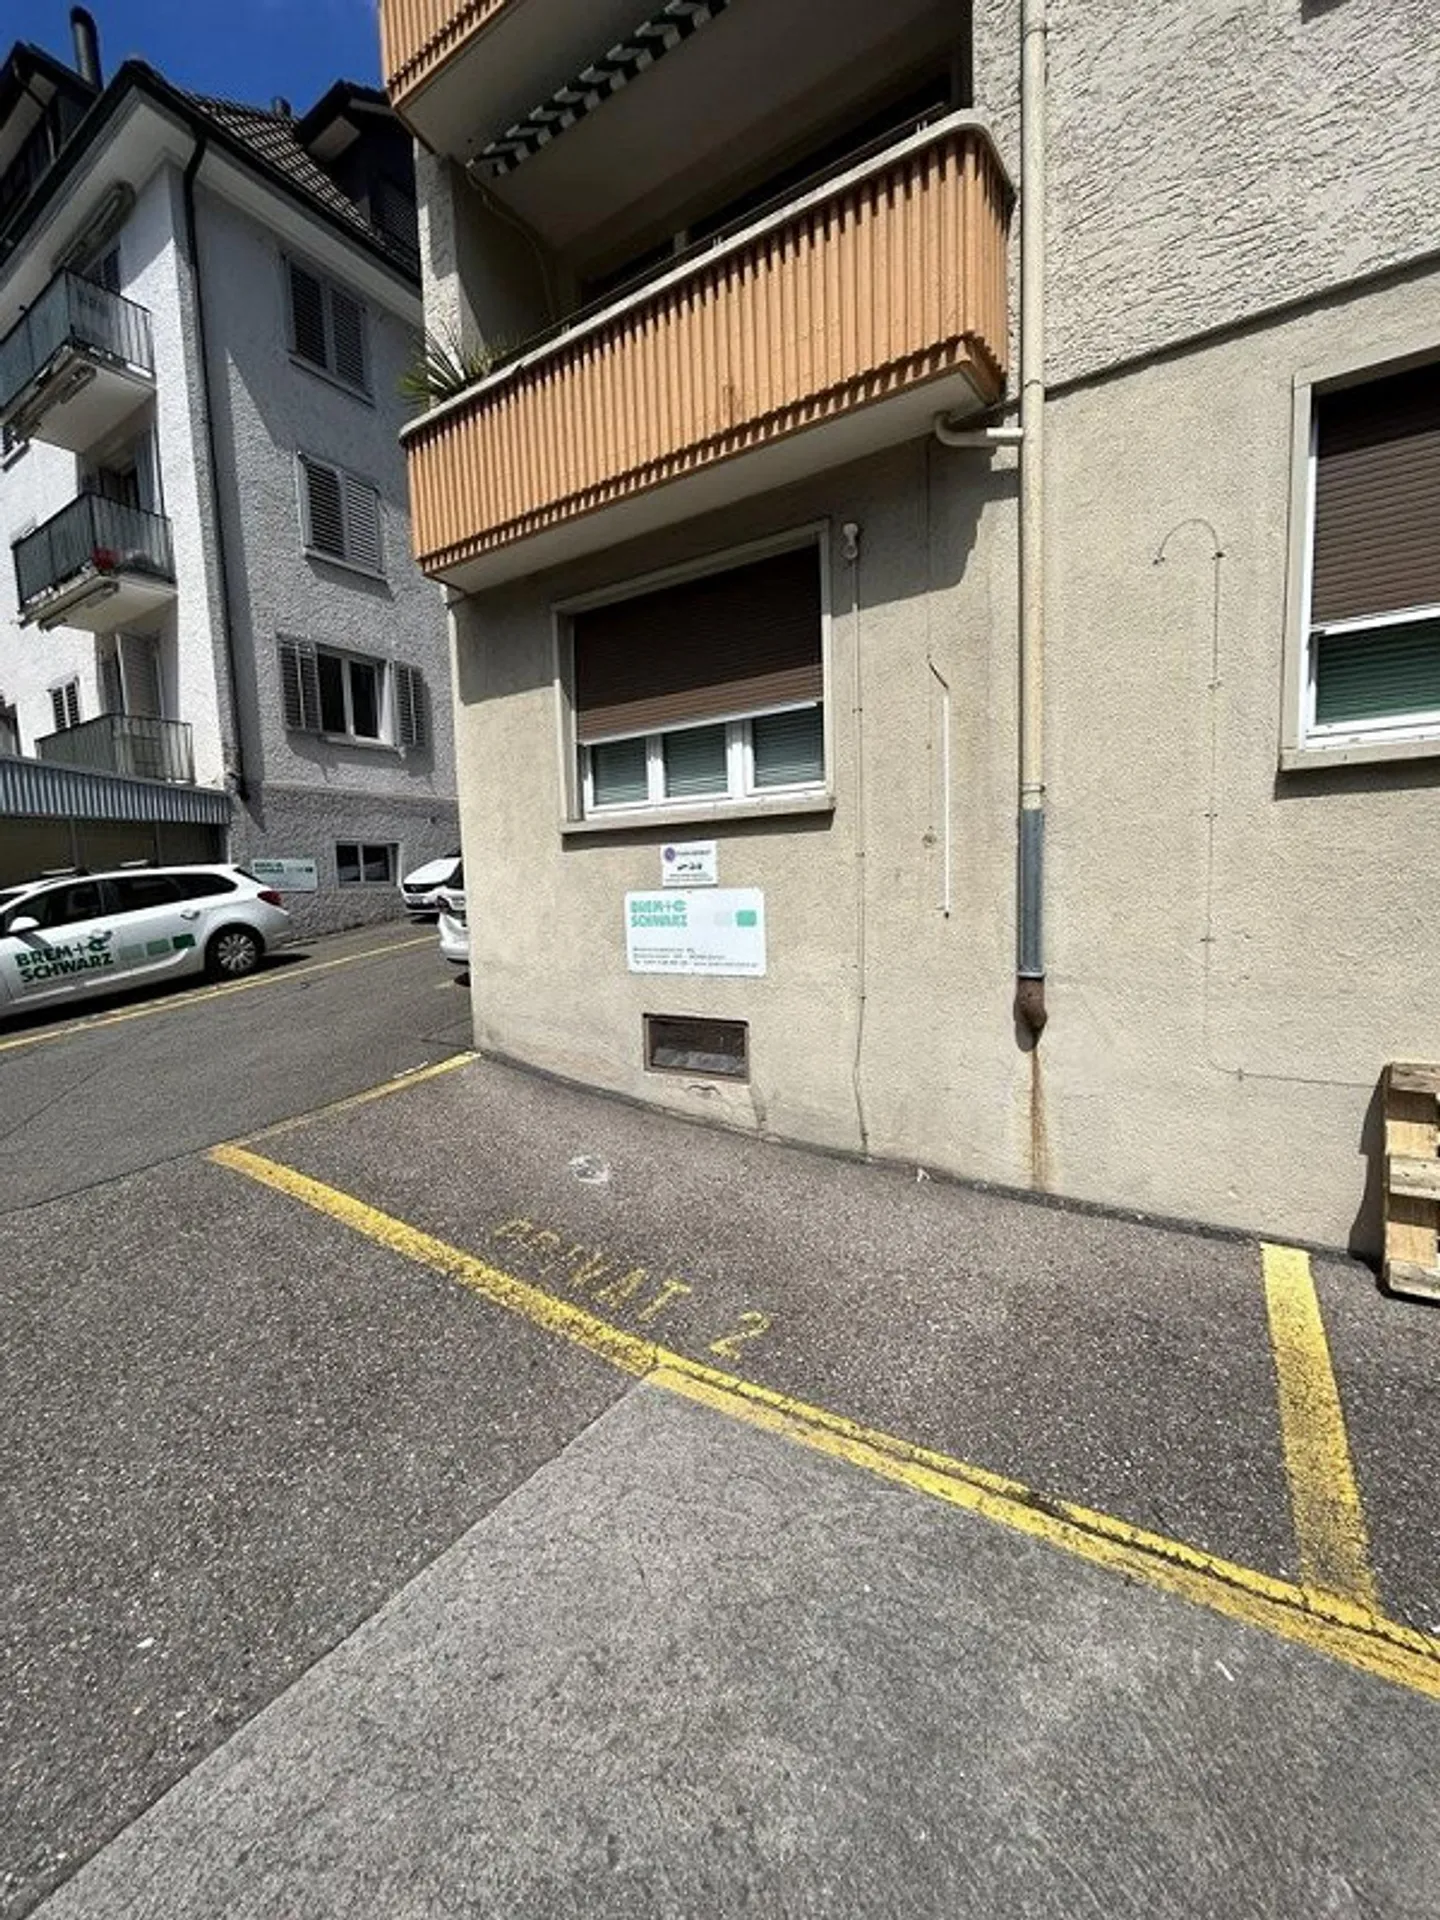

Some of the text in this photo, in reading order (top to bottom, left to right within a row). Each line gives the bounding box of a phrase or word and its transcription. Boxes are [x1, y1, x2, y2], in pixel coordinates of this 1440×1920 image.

[630, 914, 687, 928] SCHWARZ
[20, 952, 114, 983] SCHWARZ
[710, 1310, 772, 1360] 2
